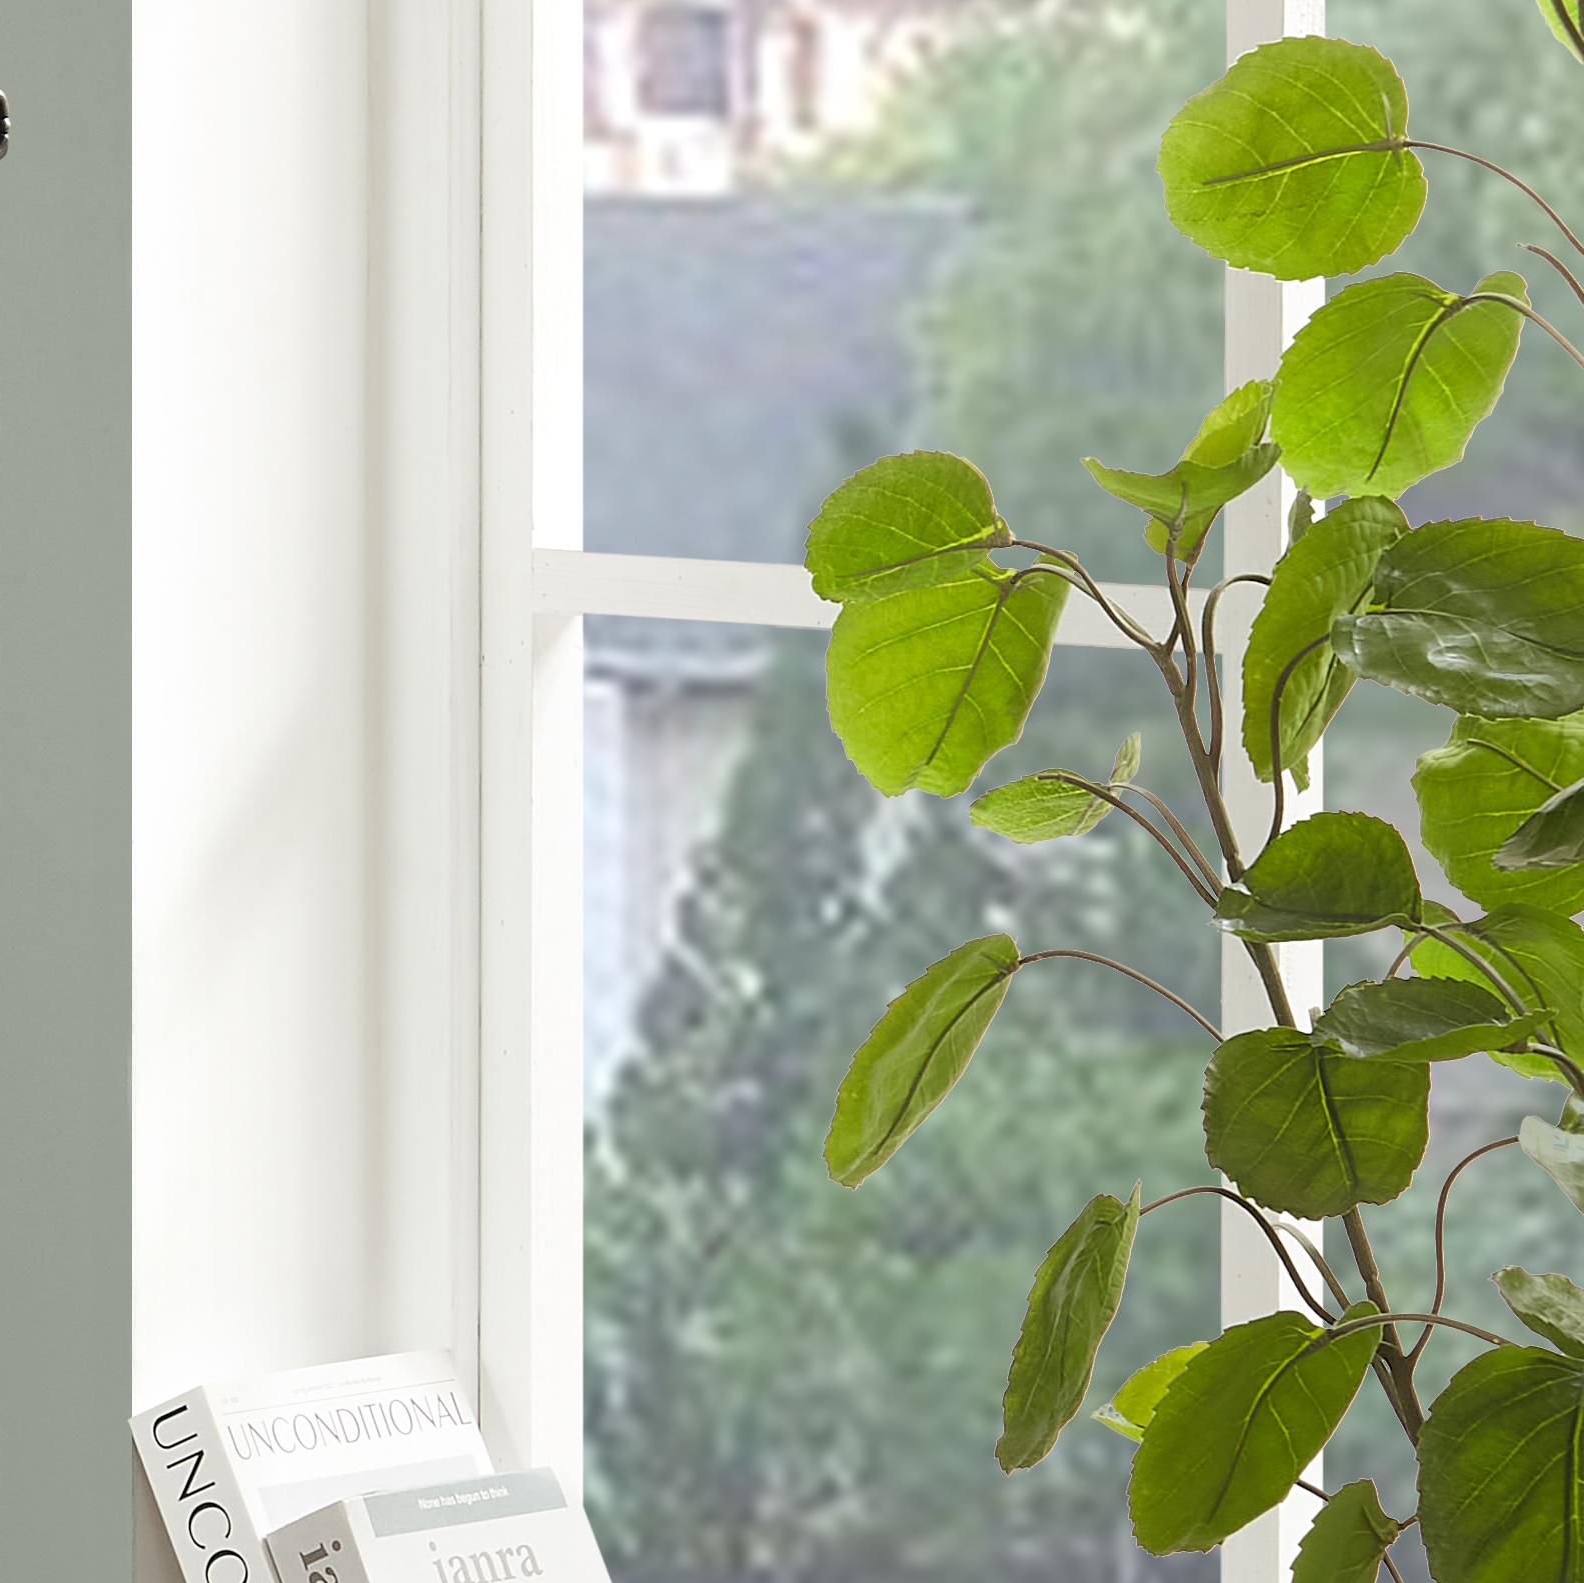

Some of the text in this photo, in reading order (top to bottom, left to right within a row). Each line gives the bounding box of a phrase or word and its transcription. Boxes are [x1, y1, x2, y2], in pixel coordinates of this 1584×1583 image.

[227, 1391, 472, 1460] UNCONDITIONAL
[417, 1497, 441, 1510] None
[439, 1495, 456, 1506] has
[479, 1489, 491, 1500] to
